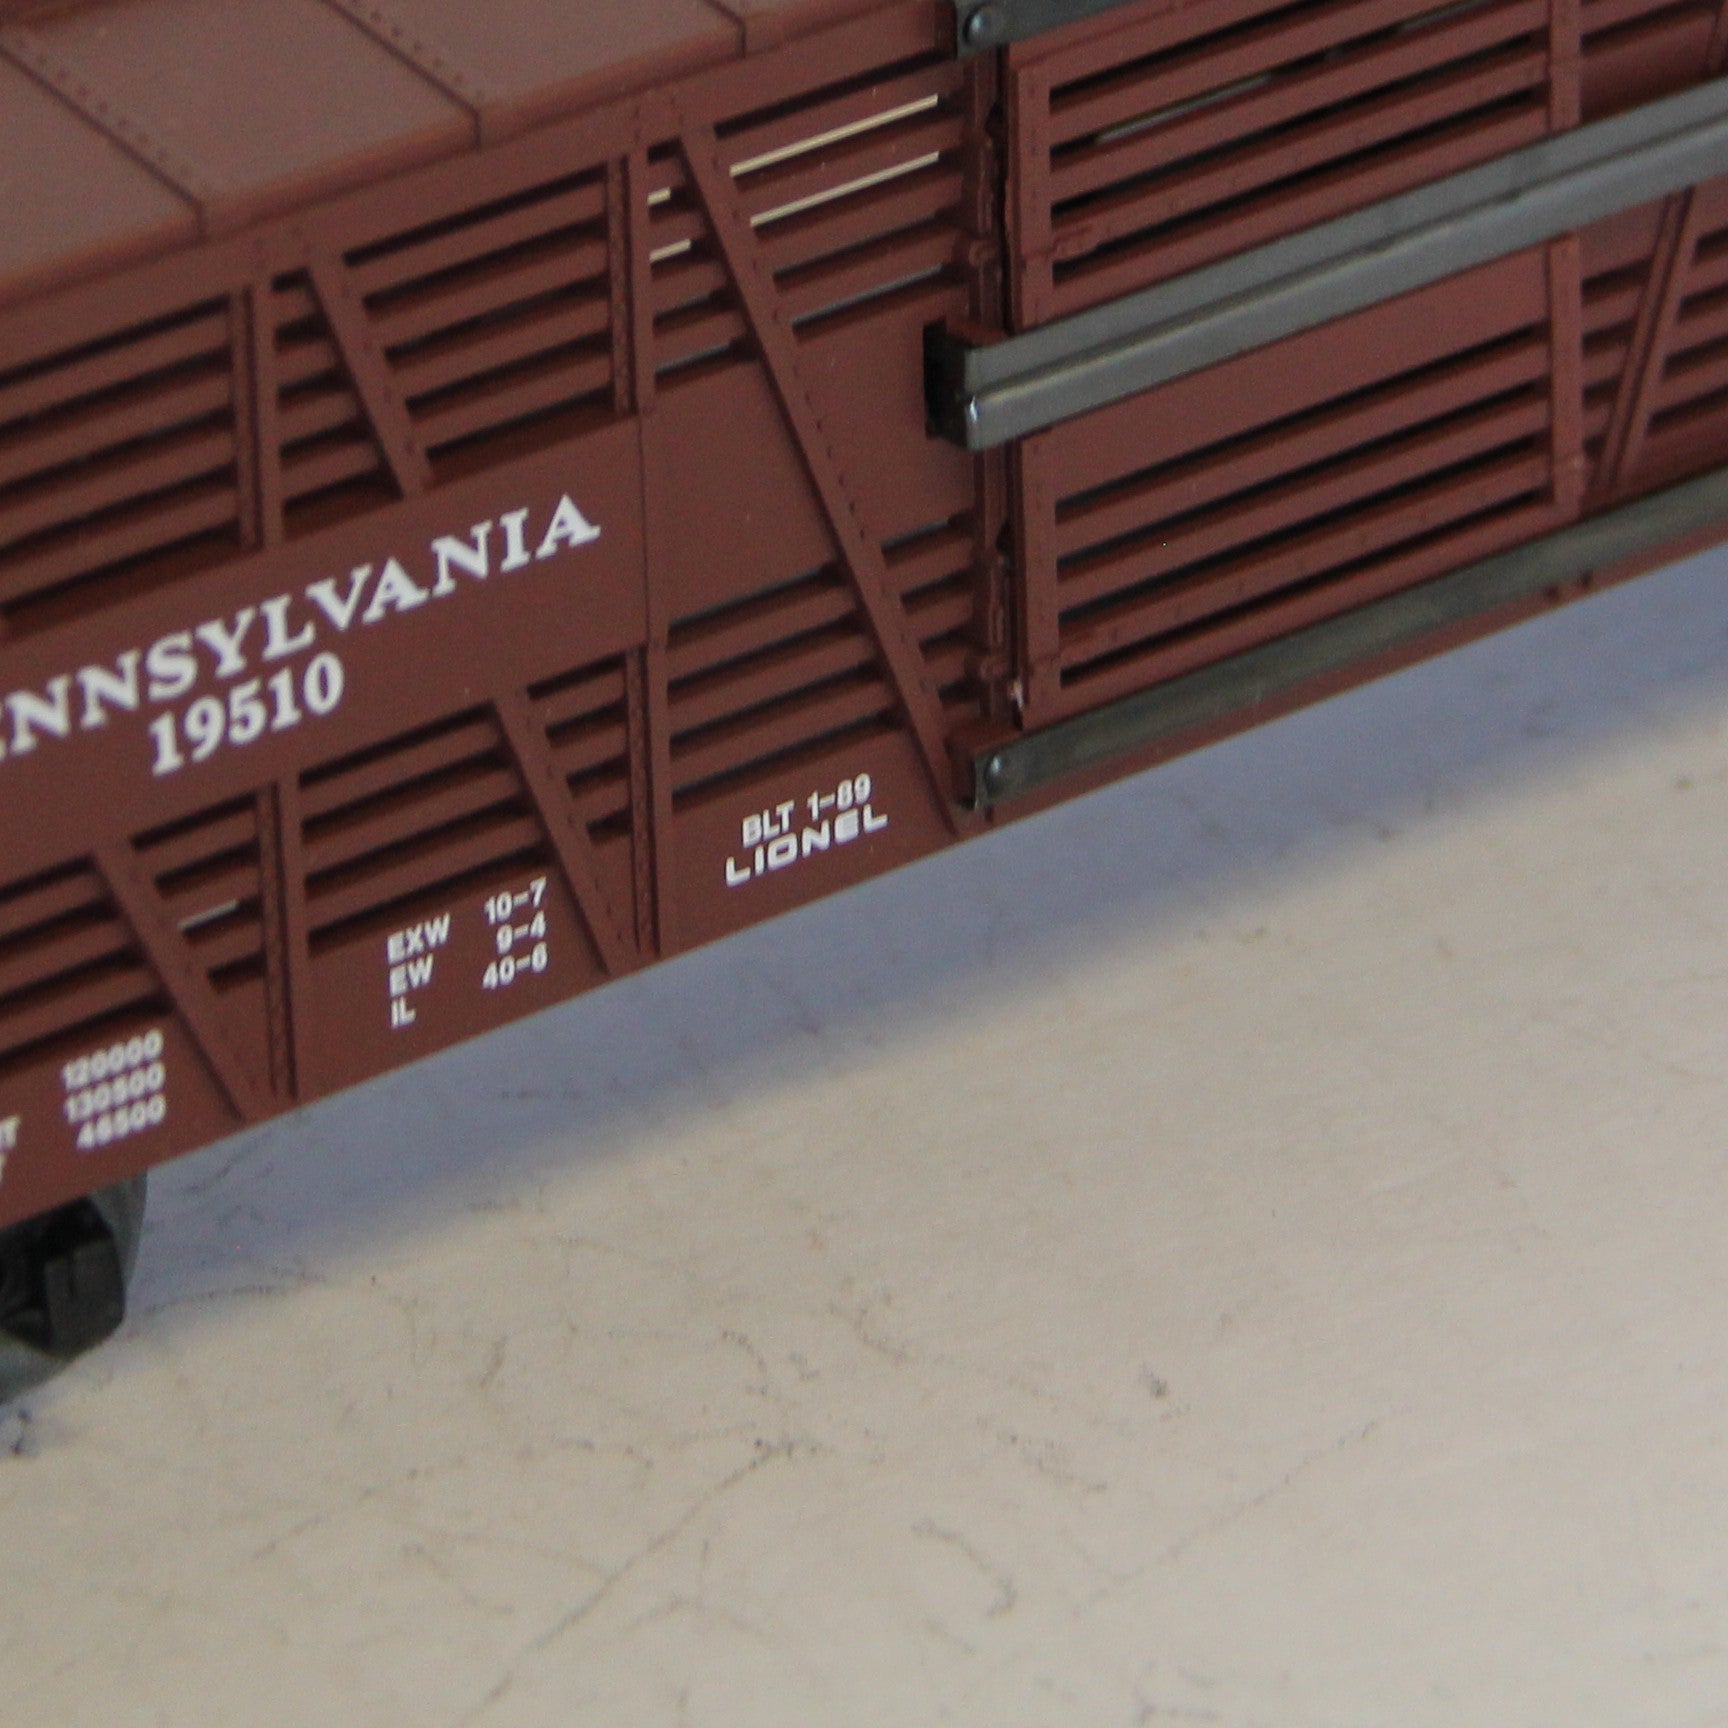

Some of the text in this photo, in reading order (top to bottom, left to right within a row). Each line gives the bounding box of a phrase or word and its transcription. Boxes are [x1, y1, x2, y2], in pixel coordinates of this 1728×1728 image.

[151, 652, 345, 776] 19510
[725, 803, 889, 888] LIONEL
[742, 772, 872, 849] BLT 1-89
[387, 876, 547, 965] EXW 10-7
[389, 952, 434, 998] EW
[391, 996, 417, 1028] IL
